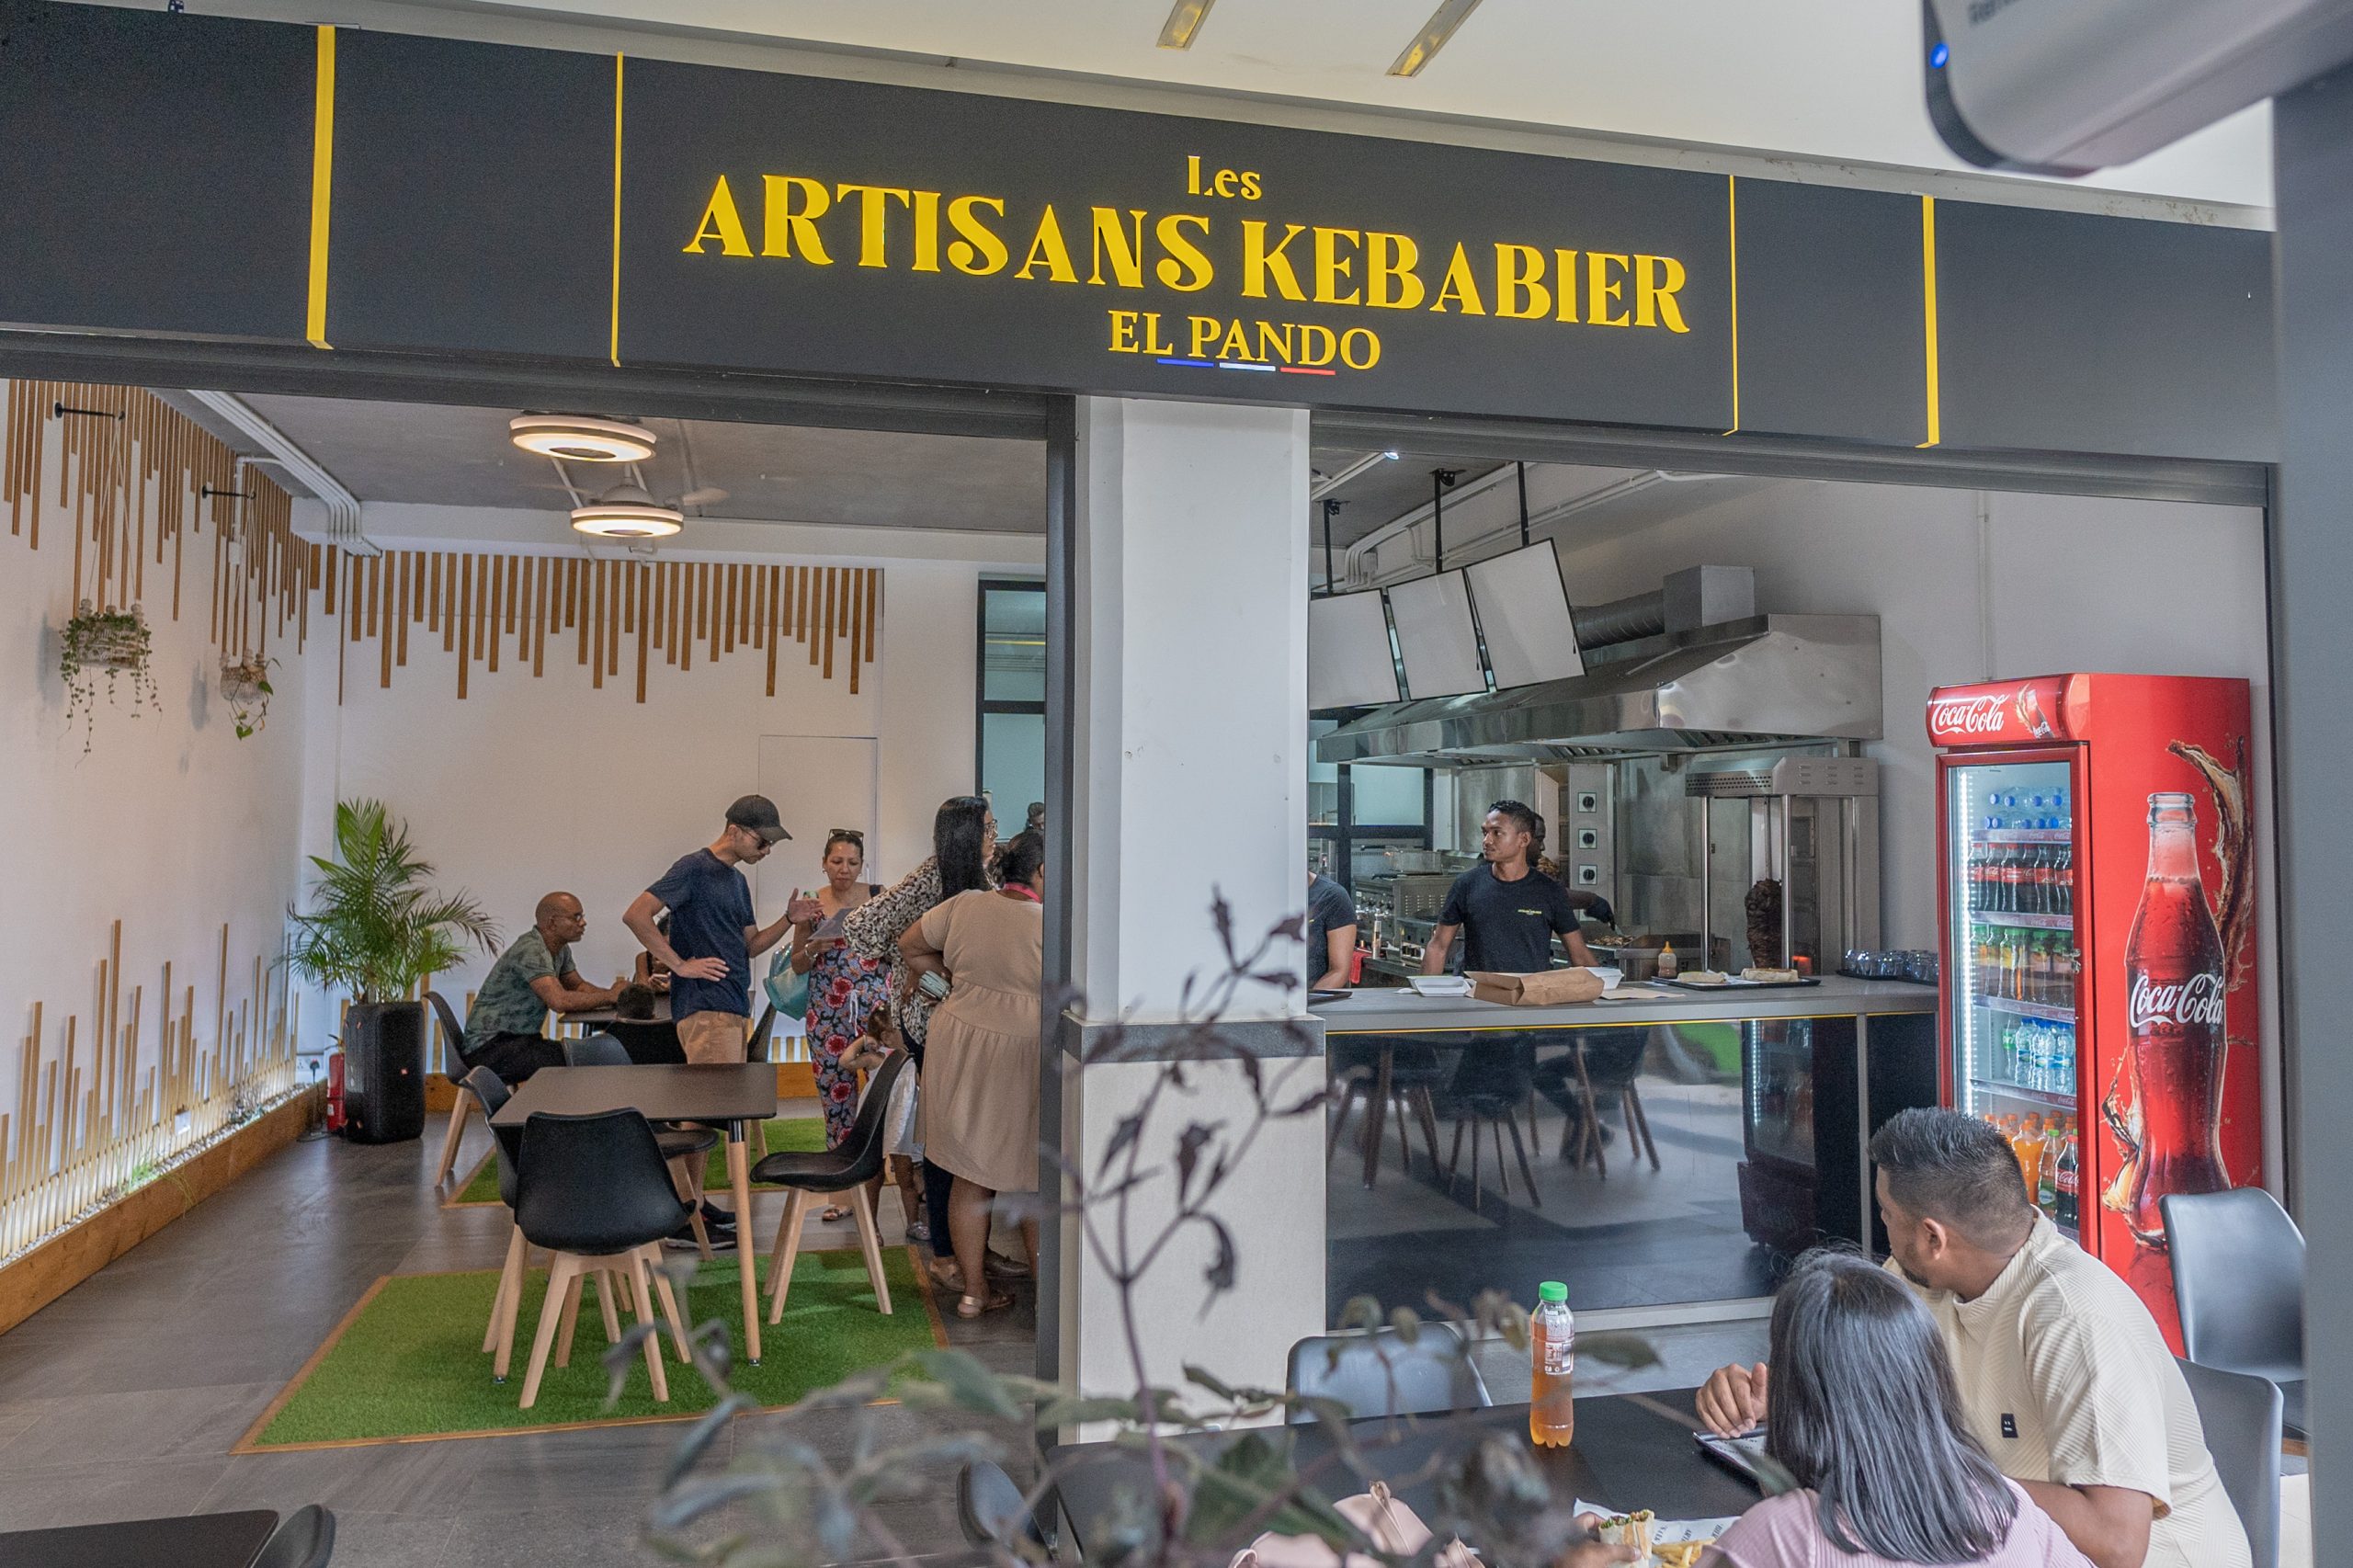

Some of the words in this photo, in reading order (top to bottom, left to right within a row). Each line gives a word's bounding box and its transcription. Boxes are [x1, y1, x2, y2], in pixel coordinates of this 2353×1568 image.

[1187, 154, 1263, 201] Les
[682, 174, 1216, 292] ARTISANS
[1240, 218, 1690, 335] KEBABIER
[1108, 309, 1174, 356] EL
[1187, 314, 1382, 370] PANDO
[1931, 694, 2010, 734] Coca-Cola
[2130, 972, 2225, 1028] Coca-Cola
